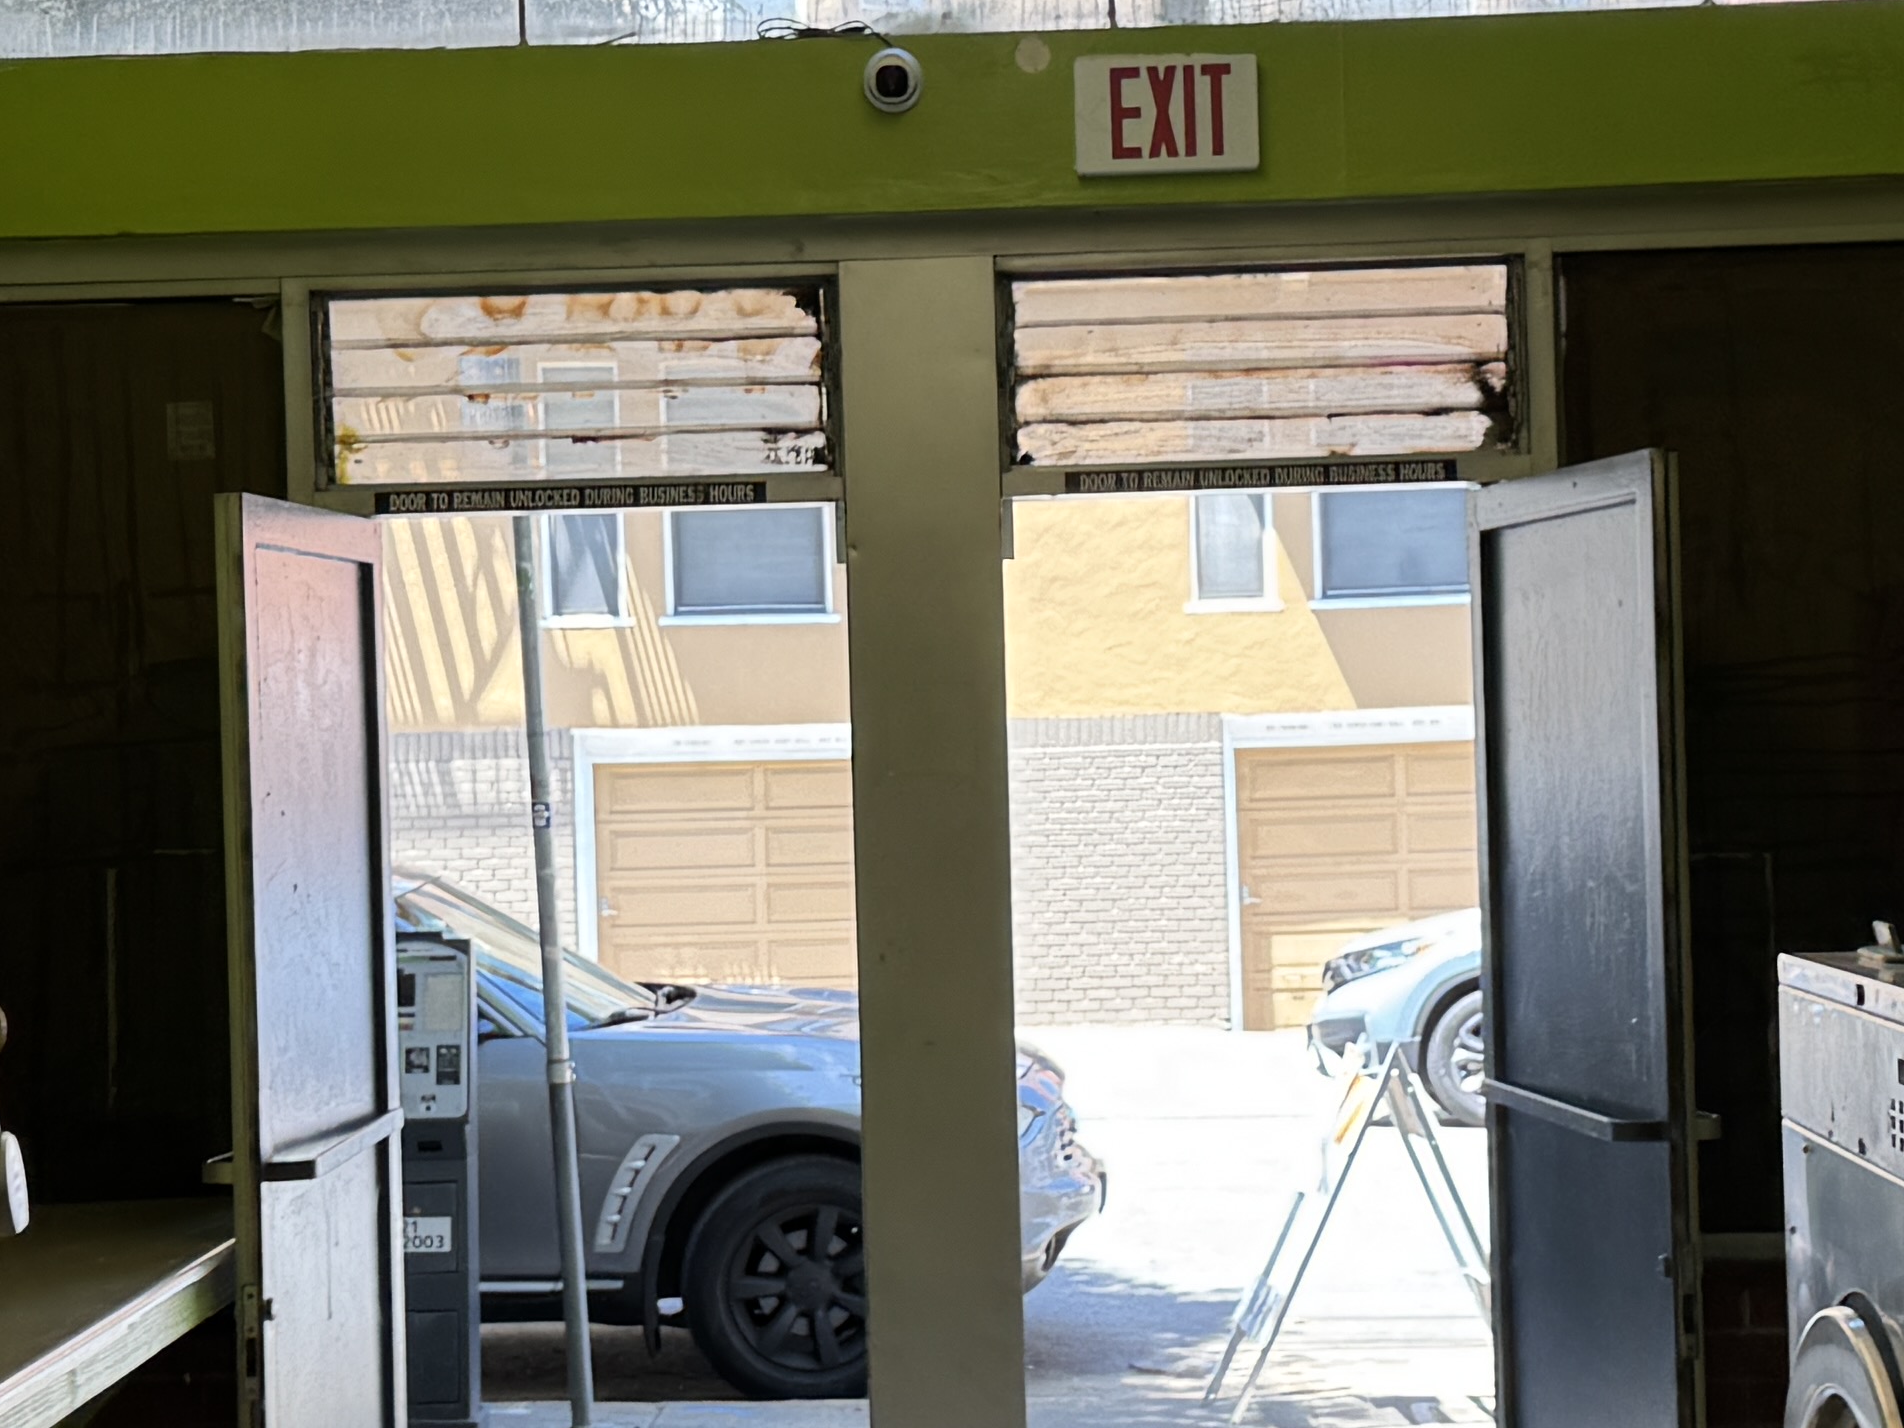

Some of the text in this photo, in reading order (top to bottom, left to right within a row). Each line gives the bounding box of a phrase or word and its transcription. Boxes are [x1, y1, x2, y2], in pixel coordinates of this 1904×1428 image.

[1108, 62, 1232, 160] EXIT
[1080, 462, 1445, 492] DOOR TO REMAIN UNLOCKED DURING BUSINESS HOURS
[390, 483, 755, 512] DOOR TO REMAIN UNLOCKED DURING BUSINESS HOURS
